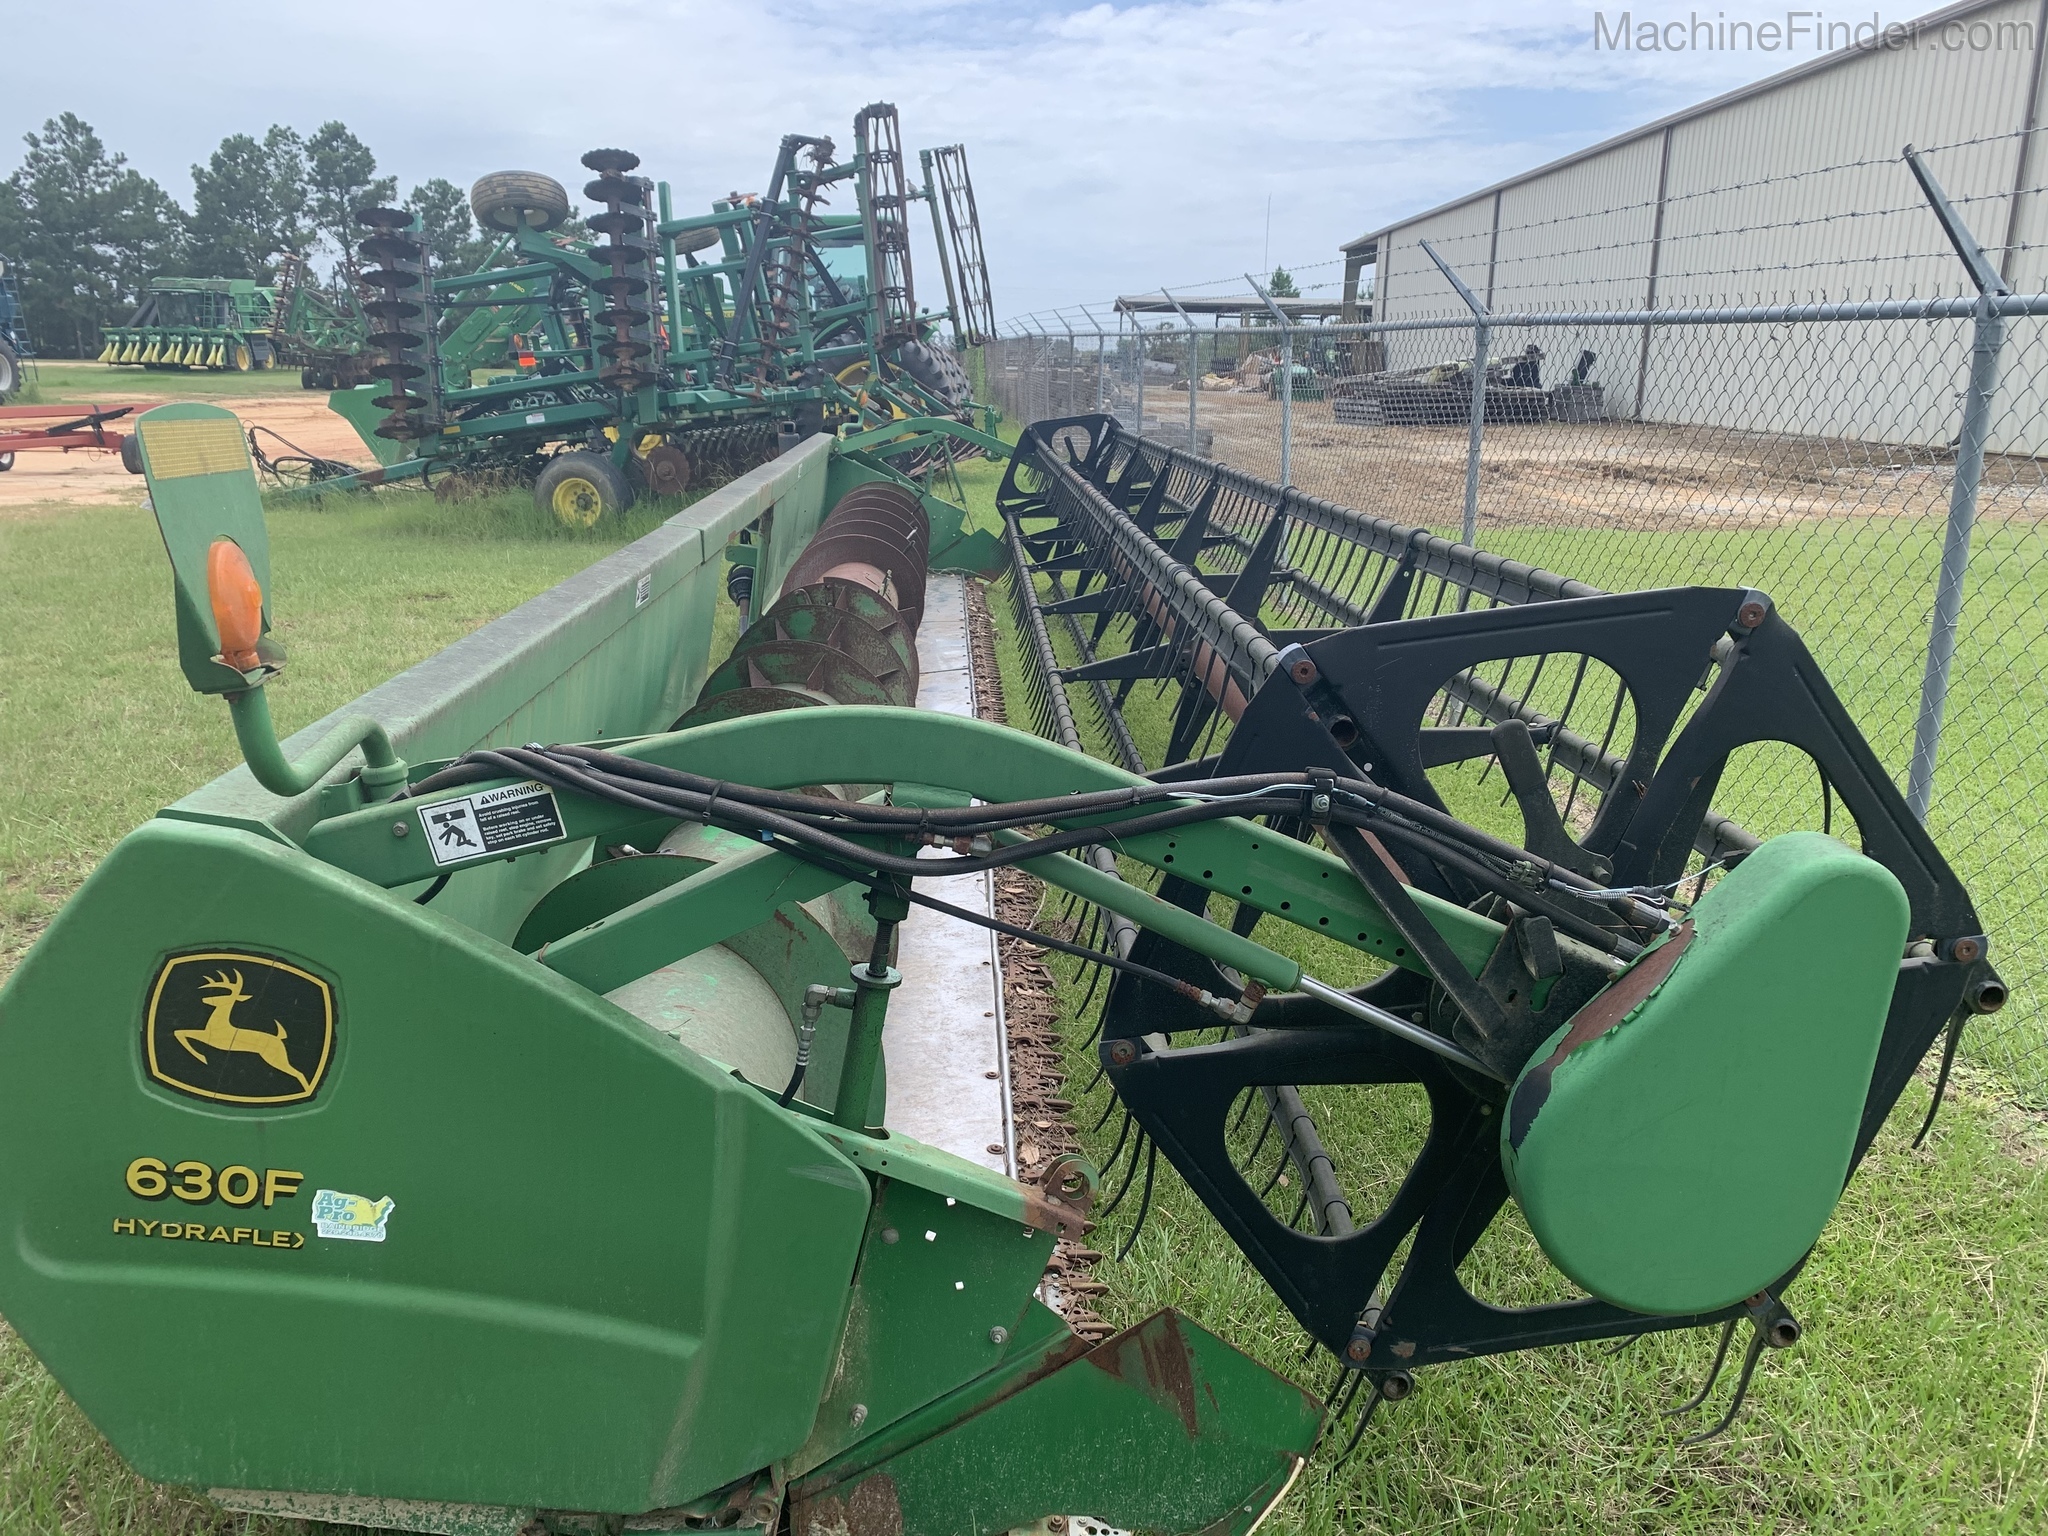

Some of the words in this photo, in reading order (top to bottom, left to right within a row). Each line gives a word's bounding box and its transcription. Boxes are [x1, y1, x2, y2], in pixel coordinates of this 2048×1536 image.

[488, 783, 543, 802] WARNING
[126, 1157, 304, 1207] 630F
[318, 1193, 356, 1209] Ag-
[317, 1207, 355, 1221] Pro
